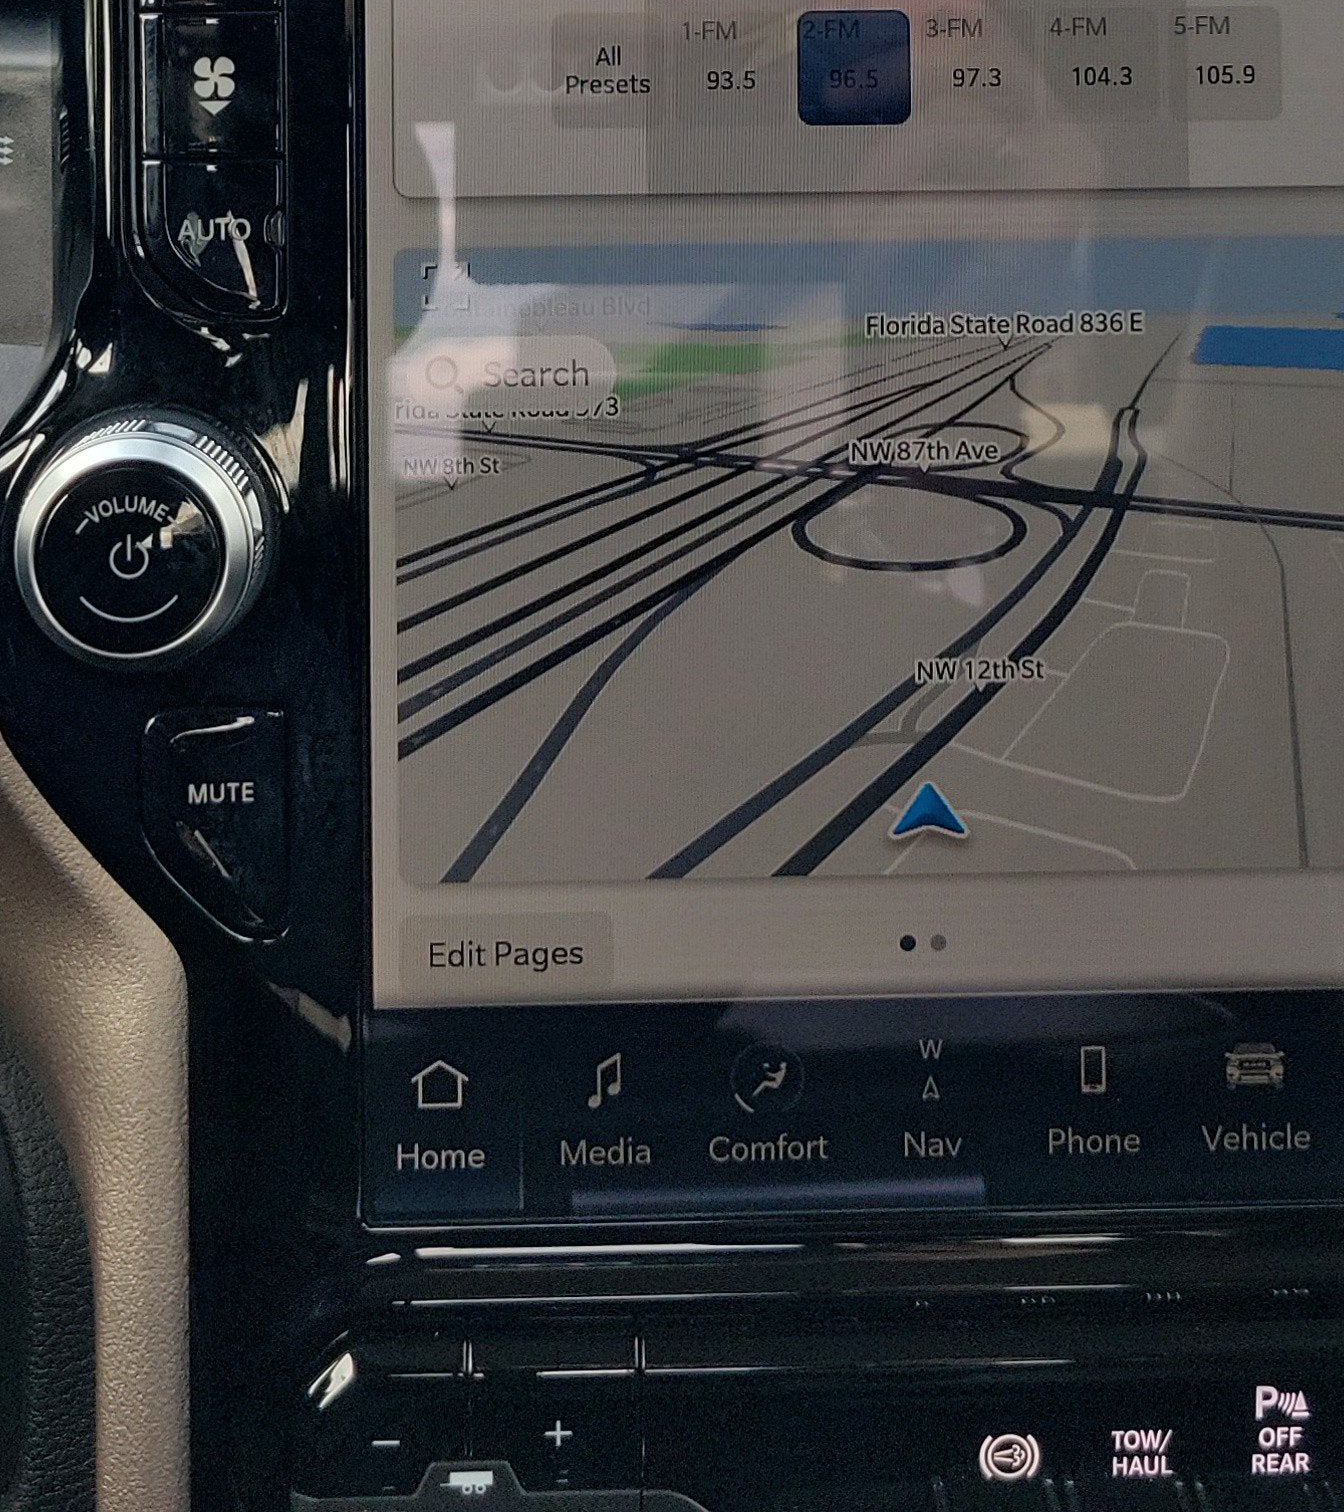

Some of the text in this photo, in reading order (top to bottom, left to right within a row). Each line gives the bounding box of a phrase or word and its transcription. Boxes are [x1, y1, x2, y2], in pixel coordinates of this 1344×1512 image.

[683, 21, 737, 41] 1-FM
[803, 20, 859, 40] 2-FM
[926, 18, 983, 38] 3-FM
[1050, 17, 1107, 37] 4-FM
[1174, 16, 1230, 35] 5-FM
[595, 46, 622, 66] All
[566, 75, 651, 95] Presets
[707, 70, 756, 90] 93.5
[829, 69, 878, 90] 96.5
[952, 68, 1002, 88] 97.3
[1072, 67, 1133, 87] 104.3
[1195, 65, 1255, 85] 105.9
[178, 218, 251, 242] AUTO
[866, 313, 1143, 335] Florida State Road 836 E
[484, 359, 589, 388] Search
[851, 441, 997, 461] NW 87th Ave
[442, 457, 475, 475] 8th
[479, 456, 500, 475] St
[85, 495, 170, 524] VOLUME
[917, 659, 1044, 680] NW 12th St
[188, 783, 255, 804] MUTE
[428, 941, 584, 973] Edit Pages
[918, 1040, 943, 1060] W
[903, 1131, 962, 1158] Nav
[1048, 1127, 1141, 1155] Phone
[1201, 1122, 1311, 1152] Vehicle
[397, 1143, 485, 1171] Home
[560, 1137, 651, 1166] Media
[709, 1133, 829, 1163] Comfort
[1111, 1430, 1173, 1454] TOW/
[1258, 1427, 1303, 1447] OFF
[1112, 1455, 1173, 1477] HAUL
[1251, 1452, 1310, 1473] REAR
